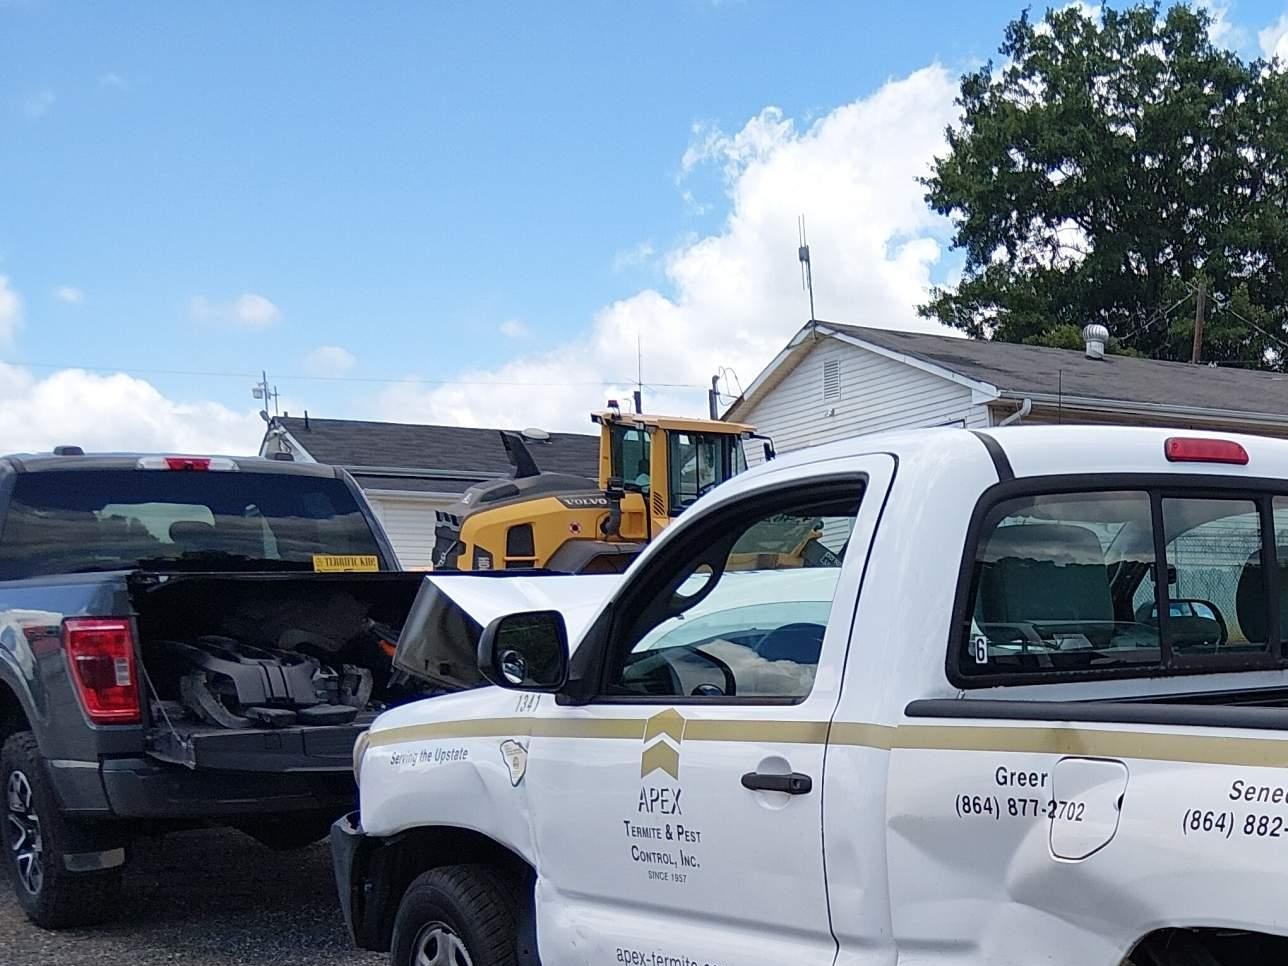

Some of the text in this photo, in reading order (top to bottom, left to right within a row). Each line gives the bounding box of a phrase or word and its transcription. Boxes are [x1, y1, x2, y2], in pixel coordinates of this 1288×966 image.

[976, 638, 985, 662] 6
[515, 694, 541, 712] 1341
[390, 748, 469, 766] Serving the Upstate
[995, 766, 1048, 788] Greer
[638, 785, 682, 815] APEX
[955, 795, 1085, 822] (864) 877-2702
[665, 824, 673, 841] &
[1183, 809, 1234, 839] (864)
[648, 870, 687, 884] SINCE 1957
